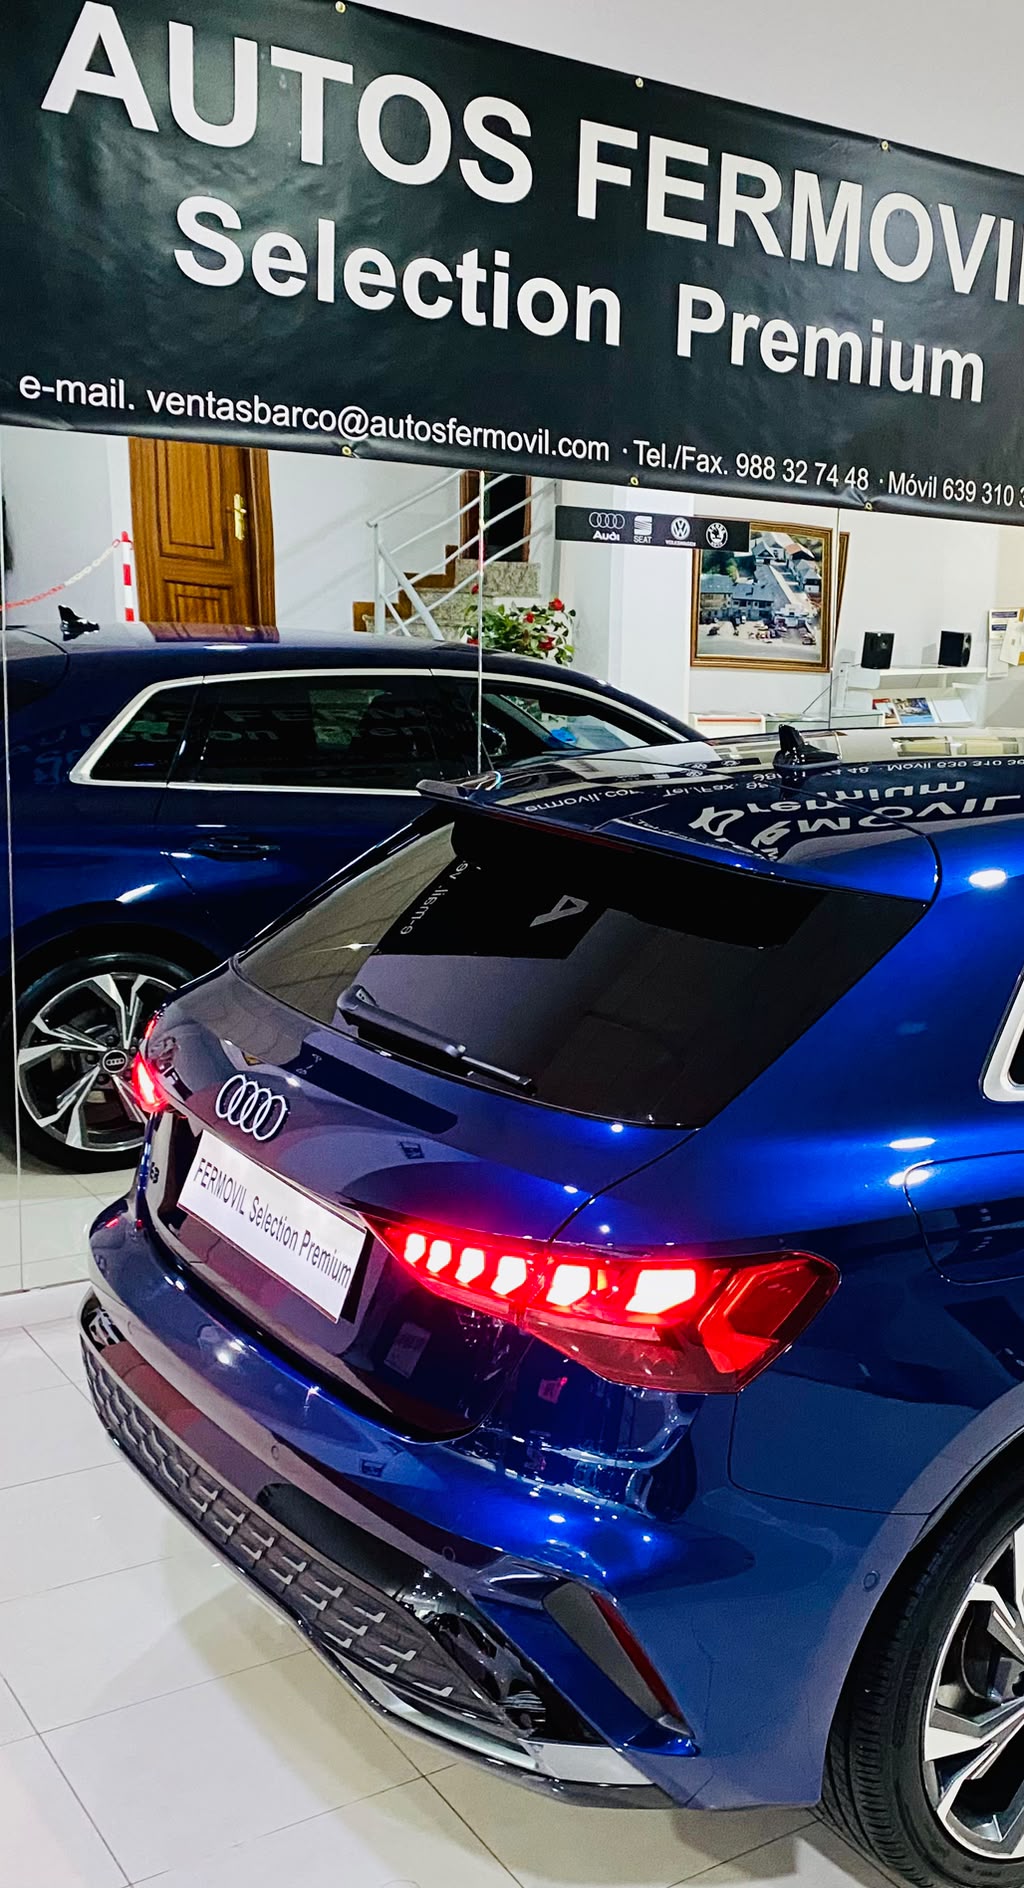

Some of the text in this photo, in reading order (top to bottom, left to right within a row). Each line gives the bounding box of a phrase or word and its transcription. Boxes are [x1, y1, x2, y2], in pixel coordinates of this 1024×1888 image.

[41, 0, 533, 204] AUTOS
[174, 195, 985, 403] Selection Premium
[19, 374, 136, 411] e-mail.
[147, 387, 610, 462] ventasbarco@autosfermovil.com
[632, 439, 729, 476] Tel./Fax.
[736, 452, 776, 481] 988
[782, 458, 808, 485] 32
[815, 462, 840, 488] 74
[844, 466, 869, 491] 48
[888, 470, 938, 499] Móvil
[942, 477, 977, 503] 639
[981, 482, 1015, 507] 310
[592, 531, 621, 541] Audi
[633, 536, 653, 544] SEAT
[193, 1157, 352, 1289] FERMOVIL Selection Premium
